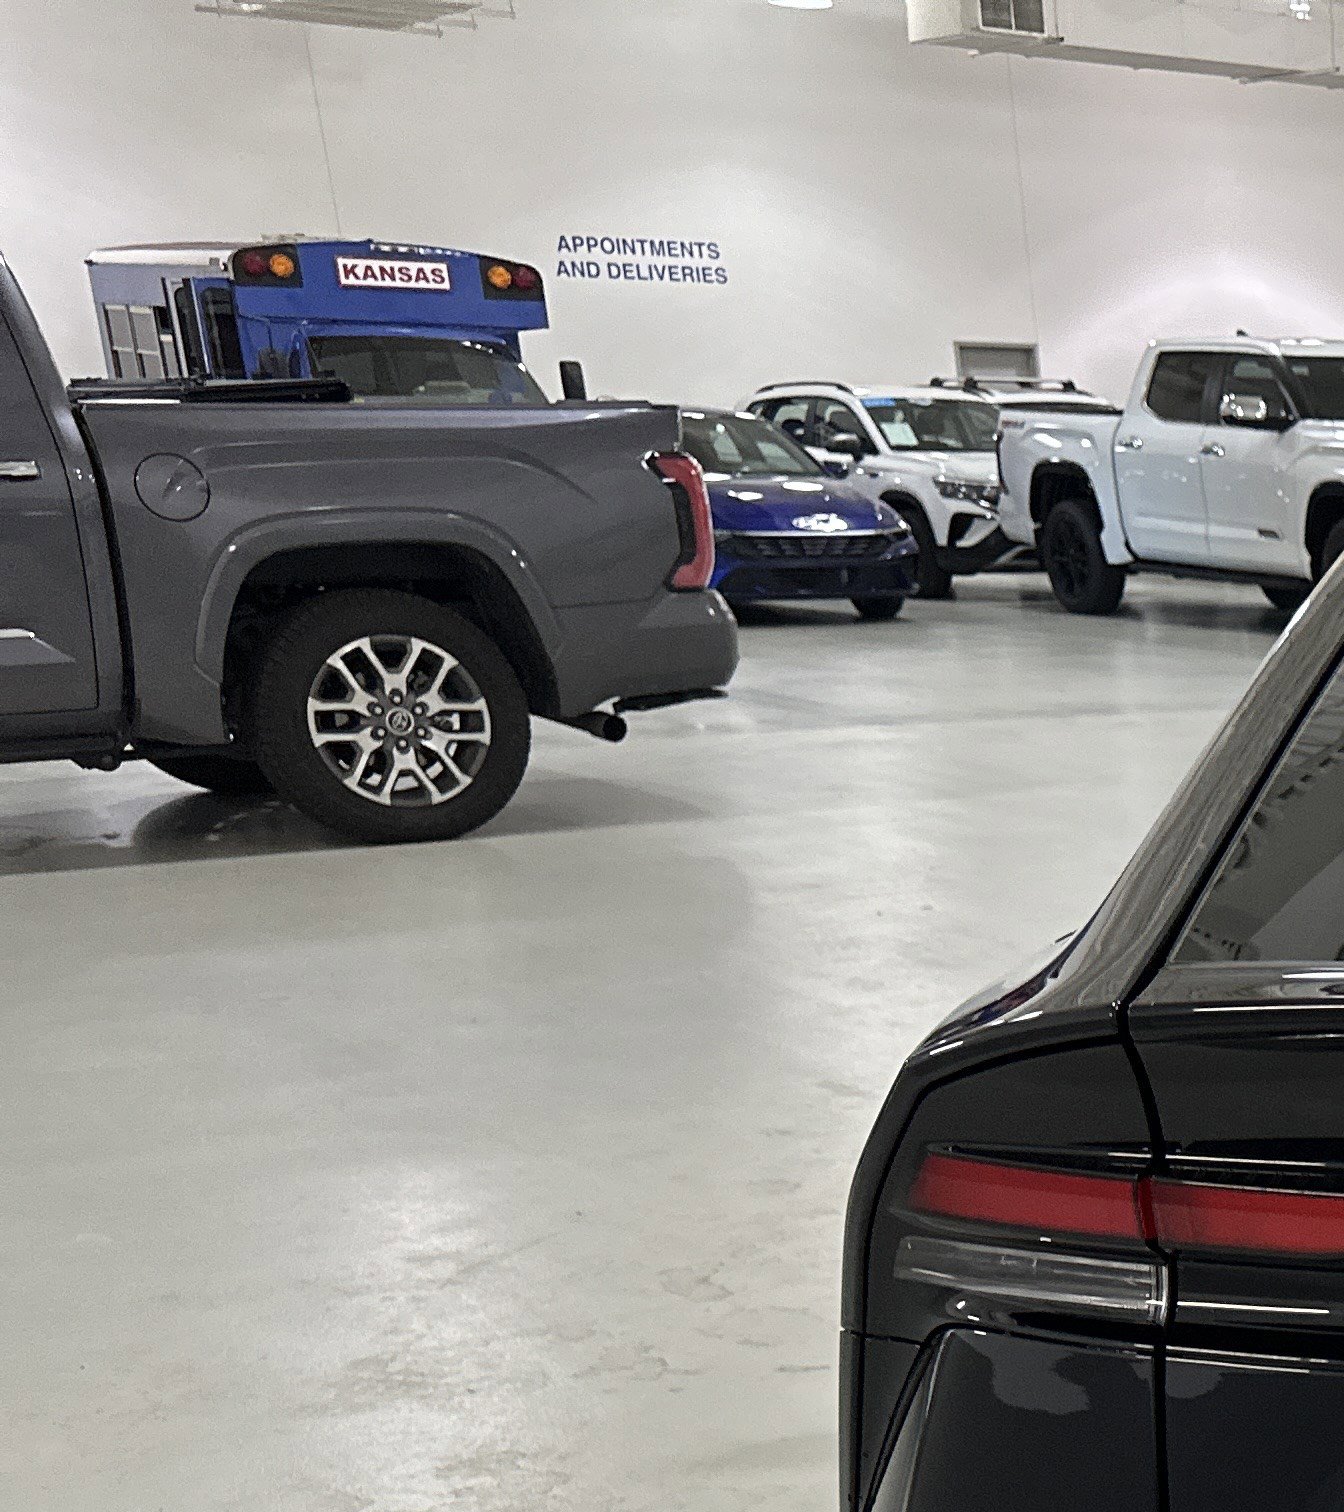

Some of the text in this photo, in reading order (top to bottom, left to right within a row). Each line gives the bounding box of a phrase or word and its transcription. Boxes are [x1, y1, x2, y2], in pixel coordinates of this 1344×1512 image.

[557, 235, 721, 260] APPOINTMENTS
[342, 263, 446, 285] KANSAS
[556, 260, 728, 285] AND DELIVERIES
